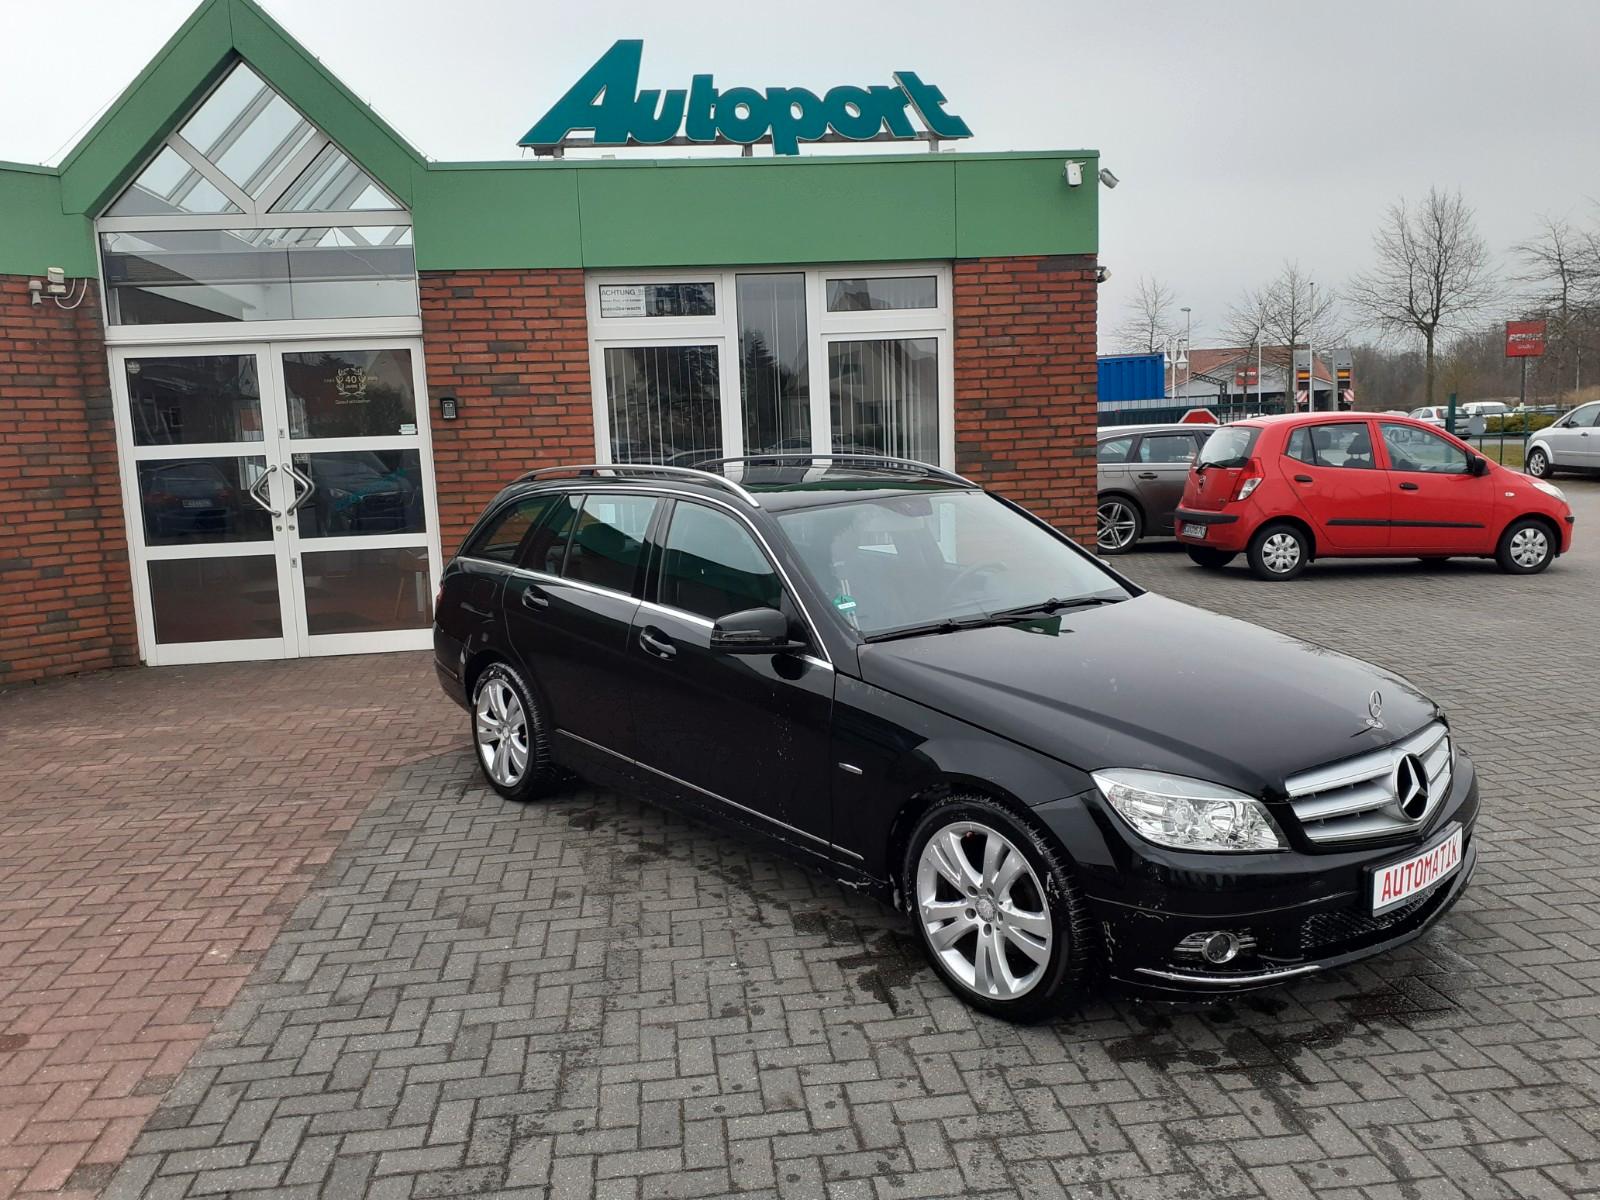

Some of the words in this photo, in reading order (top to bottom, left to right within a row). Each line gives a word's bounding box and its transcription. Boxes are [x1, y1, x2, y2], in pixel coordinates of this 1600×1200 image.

[517, 39, 974, 156] Autoport
[601, 288, 636, 296] ACHTUNG
[345, 375, 357, 384] 40
[1381, 834, 1458, 902] AUTOMATIK
